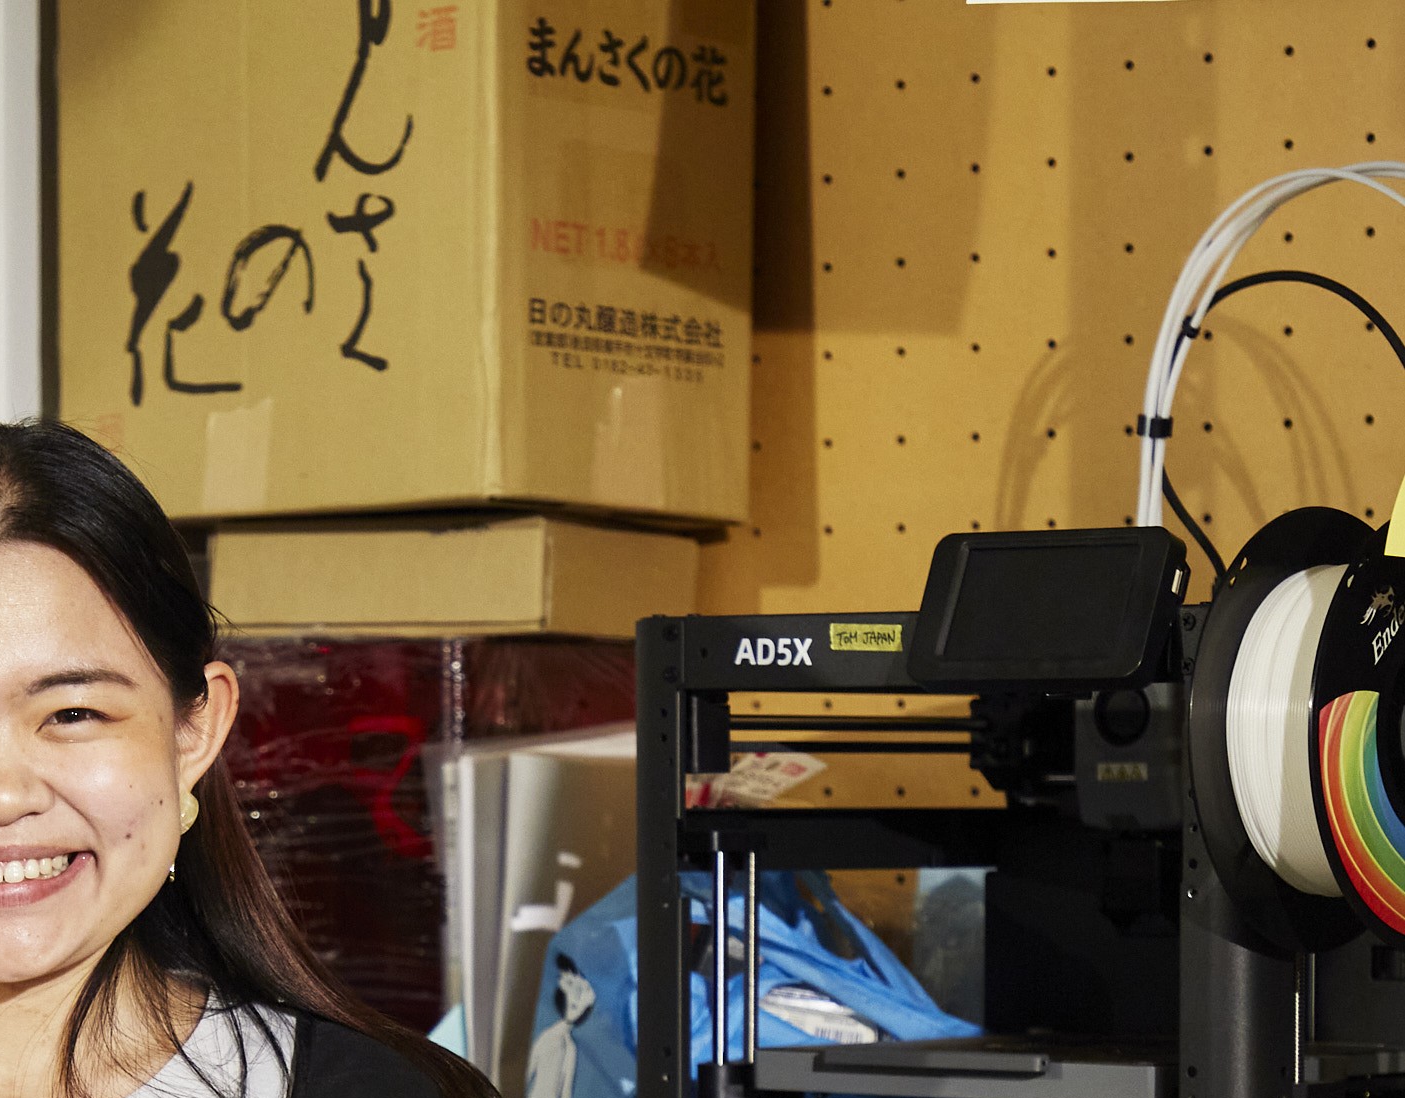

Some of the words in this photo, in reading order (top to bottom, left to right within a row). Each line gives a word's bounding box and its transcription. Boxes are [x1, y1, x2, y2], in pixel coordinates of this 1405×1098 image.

[414, 5, 459, 52] 酒
[527, 16, 729, 107] まんさくの花
[531, 217, 588, 256] NET
[734, 637, 813, 666] AD5X
[862, 630, 896, 646] JAPAN
